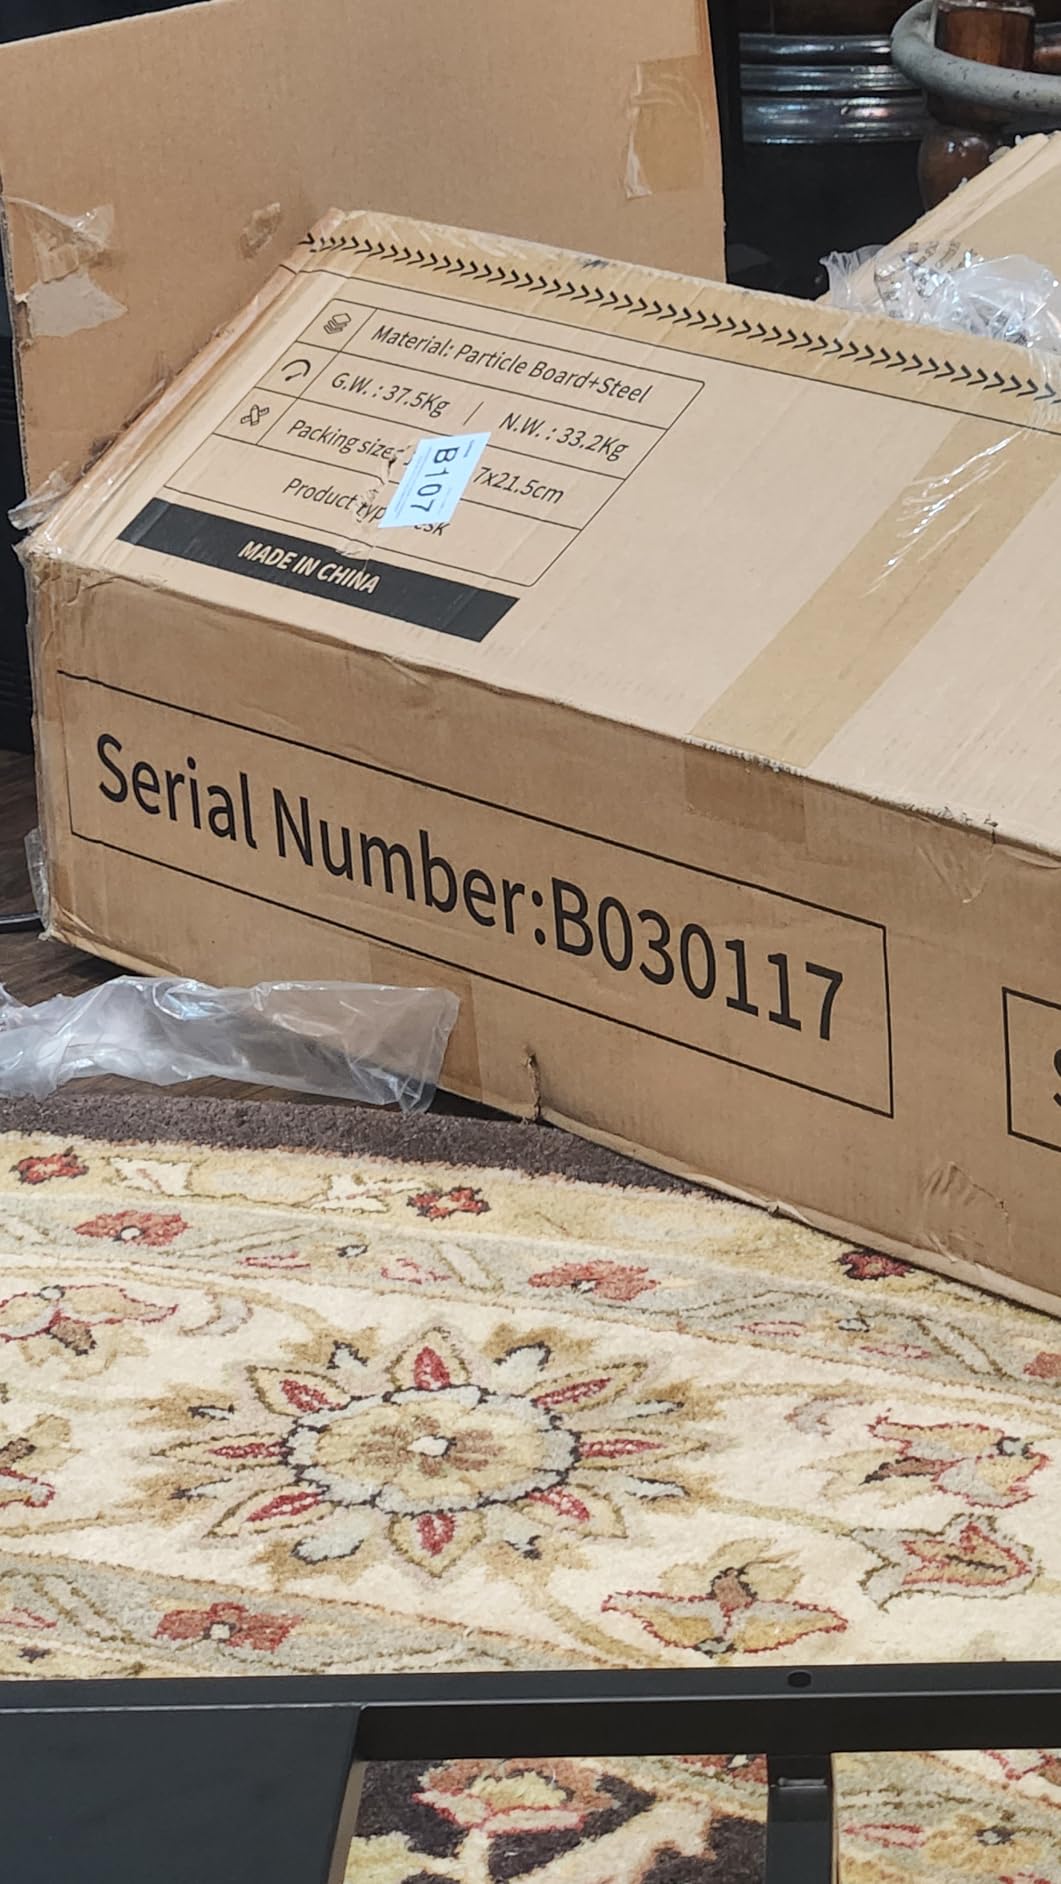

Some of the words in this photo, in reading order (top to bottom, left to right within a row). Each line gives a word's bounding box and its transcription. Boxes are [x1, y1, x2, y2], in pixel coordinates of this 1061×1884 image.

[371, 325, 454, 357] Material:
[454, 344, 528, 374] Particle
[528, 361, 653, 403] Board+Steel
[382, 385, 450, 418] 37.5Kg
[287, 419, 360, 454] Packing
[472, 466, 564, 504] 7x21.5cm
[556, 427, 629, 462] 33.2Kg
[282, 478, 357, 510] Product
[356, 502, 388, 524] typ
[410, 447, 460, 512] B107
[238, 541, 298, 570] MADE
[292, 555, 321, 576] IN
[317, 562, 380, 594] CHINA
[97, 733, 257, 850] Serial
